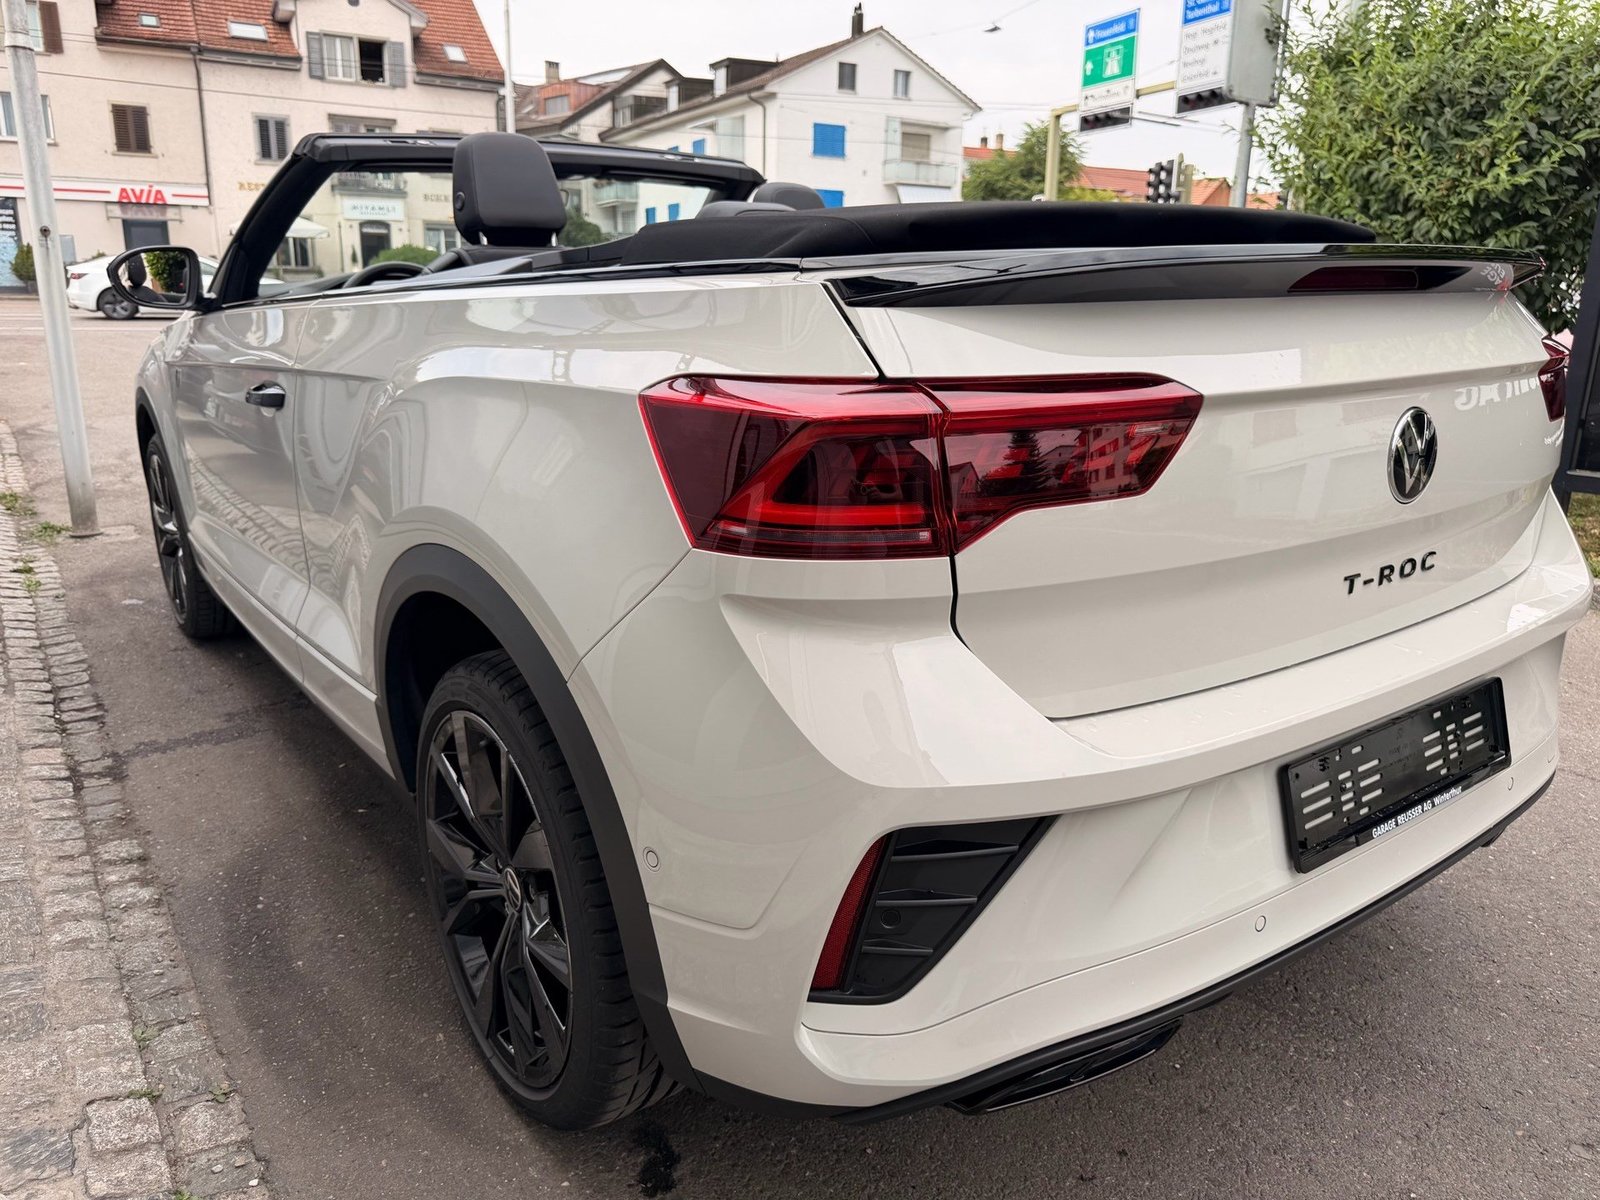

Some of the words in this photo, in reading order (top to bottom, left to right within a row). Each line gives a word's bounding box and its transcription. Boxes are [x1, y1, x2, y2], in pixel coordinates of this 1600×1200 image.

[118, 185, 168, 204] AVIA
[1344, 551, 1437, 595] T-ROC
[1372, 818, 1397, 838] GARAGE
[1397, 805, 1423, 825] REUSSER
[1423, 801, 1432, 812] AG
[1433, 786, 1462, 806] Winterthur
